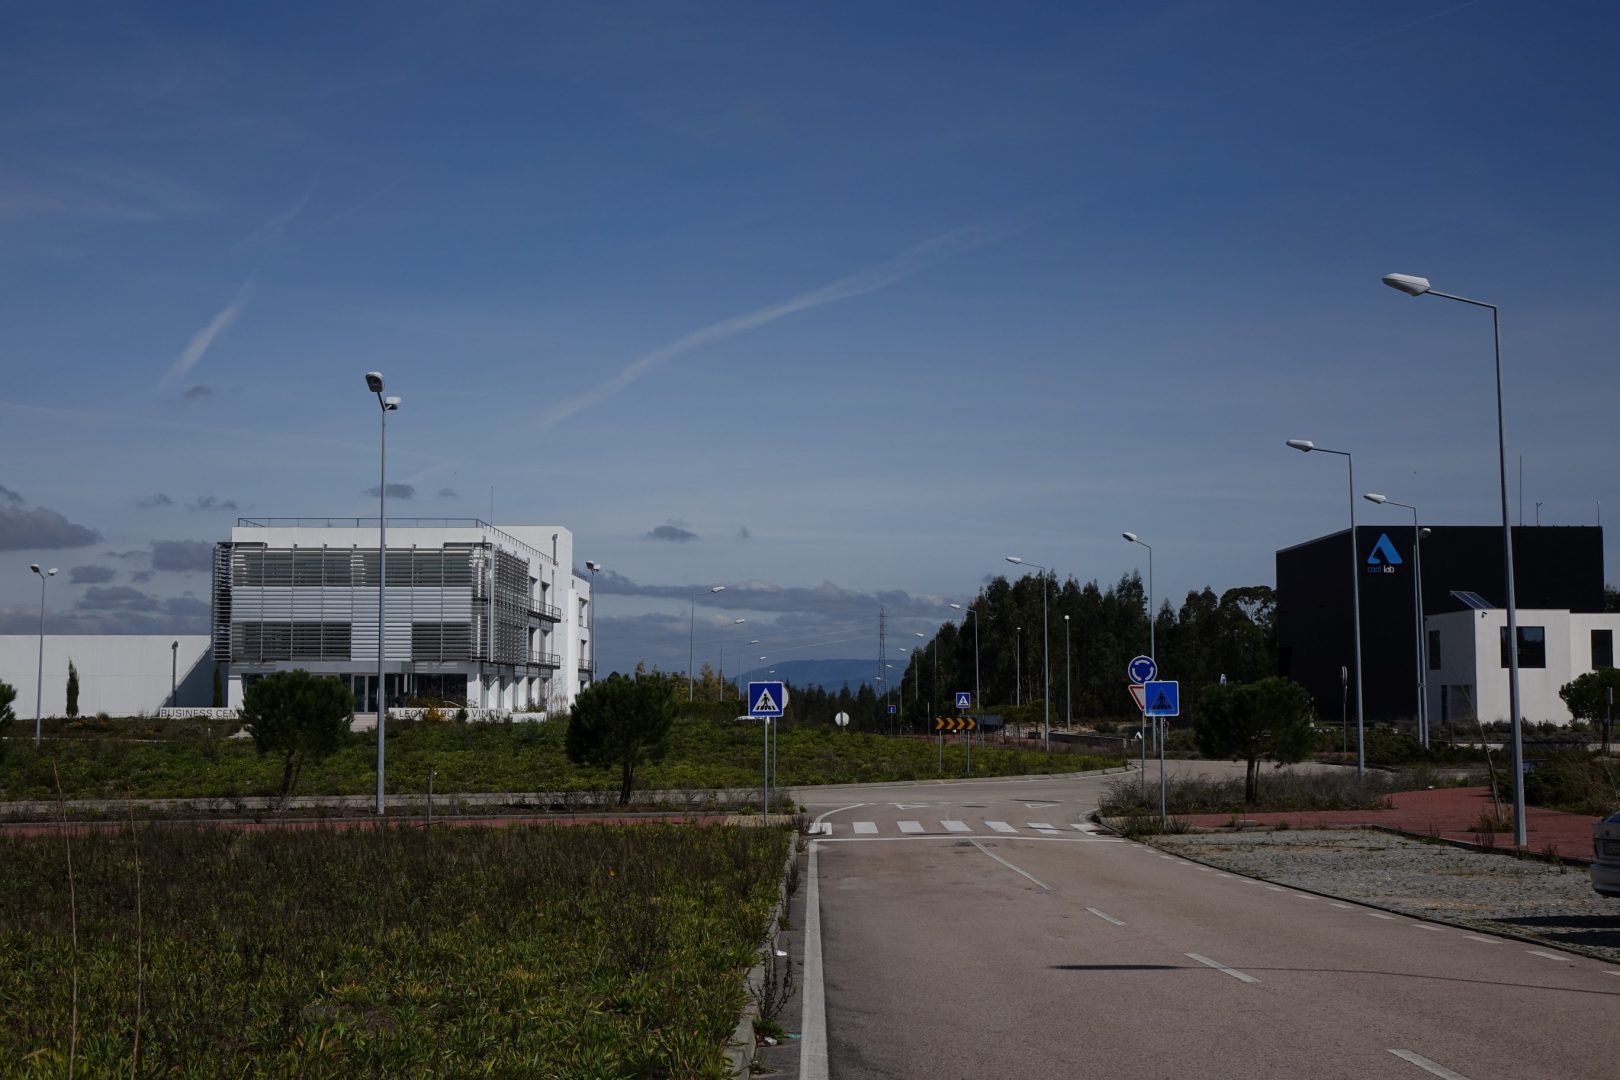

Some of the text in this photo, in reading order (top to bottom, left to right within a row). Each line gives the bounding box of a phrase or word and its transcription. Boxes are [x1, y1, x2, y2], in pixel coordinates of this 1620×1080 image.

[1383, 565, 1395, 573] lab
[161, 709, 236, 718] BUSINESS CEN
